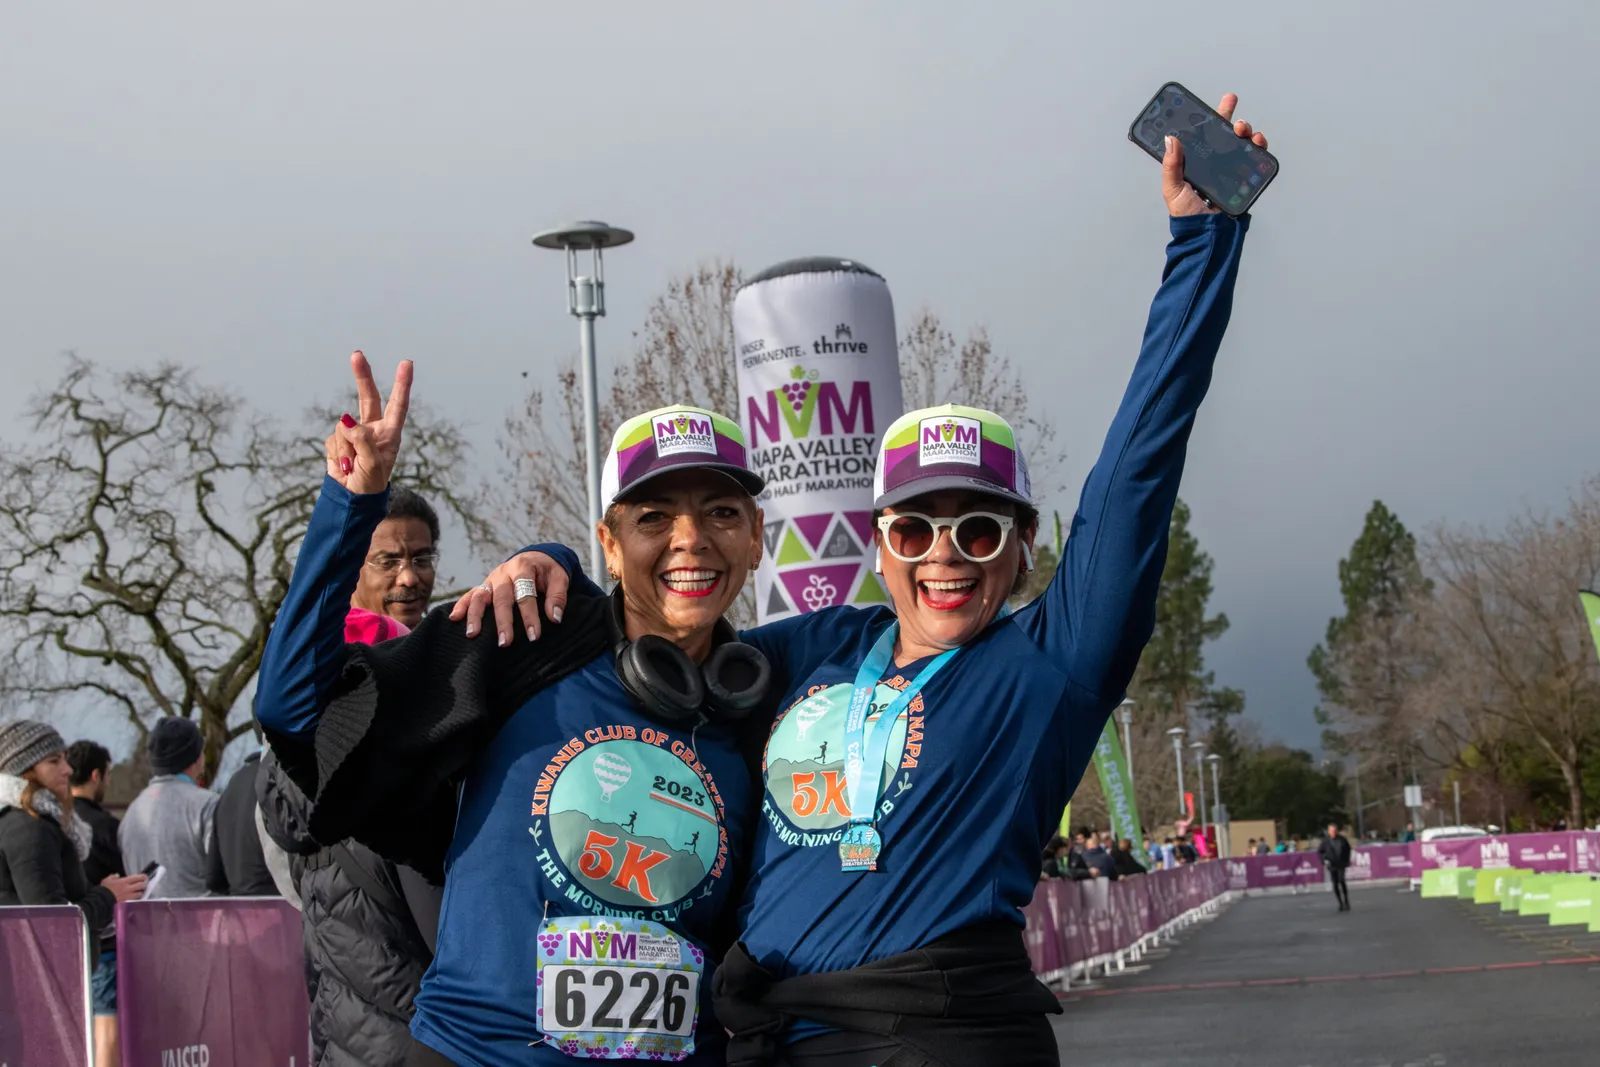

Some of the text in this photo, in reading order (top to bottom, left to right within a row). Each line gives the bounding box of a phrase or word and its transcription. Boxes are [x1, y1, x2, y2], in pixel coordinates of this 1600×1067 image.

[812, 335, 868, 354] thrive
[656, 417, 711, 438] NVM
[747, 381, 875, 449] NVM
[659, 434, 711, 444] NAPA VALLEY
[660, 440, 713, 450] MARATHON
[923, 423, 977, 445] NVM
[923, 442, 977, 451] NAPA VALLEY
[752, 437, 876, 471] NAPA VALLEY
[923, 449, 977, 458] MARATHON
[774, 482, 803, 498] HALF
[901, 715, 925, 769] NAPA
[531, 725, 728, 878] KIWANIS CLUB OF GREATER NAPA
[652, 775, 706, 807] 2023
[792, 771, 852, 817] 5K
[762, 799, 783, 833] THE
[578, 829, 672, 903] 5K
[536, 848, 566, 888] THE
[565, 883, 646, 921] MORNING
[569, 931, 637, 960] NVM
[554, 968, 690, 1032] 6226
